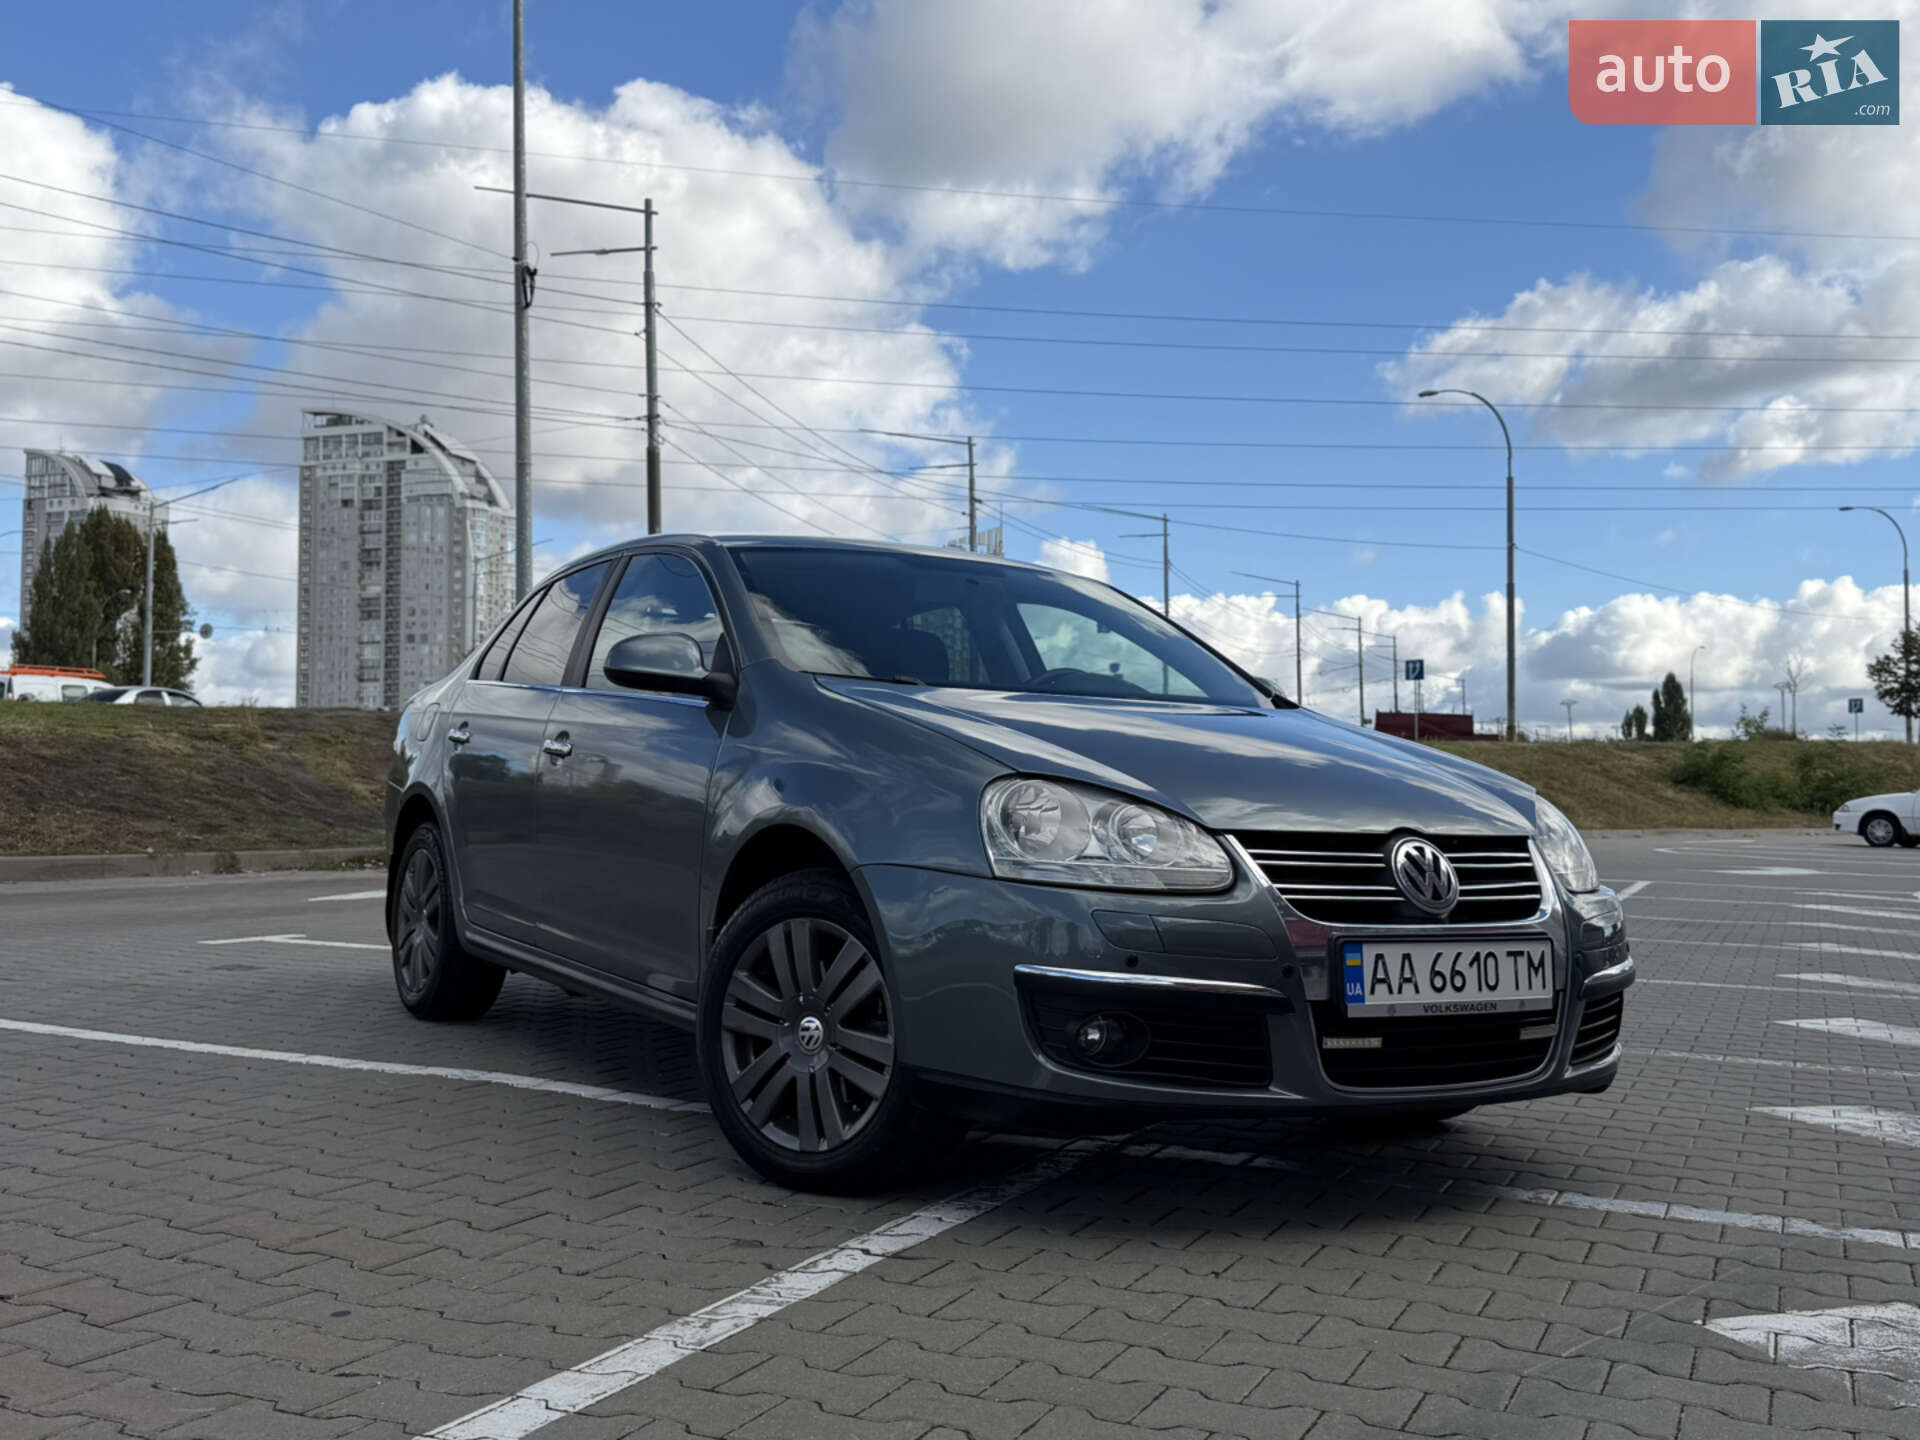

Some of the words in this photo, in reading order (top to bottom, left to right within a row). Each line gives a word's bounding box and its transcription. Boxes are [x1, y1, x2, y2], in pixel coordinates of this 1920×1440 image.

[1369, 953, 1420, 996] AA
[1429, 951, 1500, 994] 6610
[1506, 949, 1547, 992] TM
[1346, 982, 1363, 996] UA
[1422, 1001, 1498, 1014] VOLKSWAGEN
